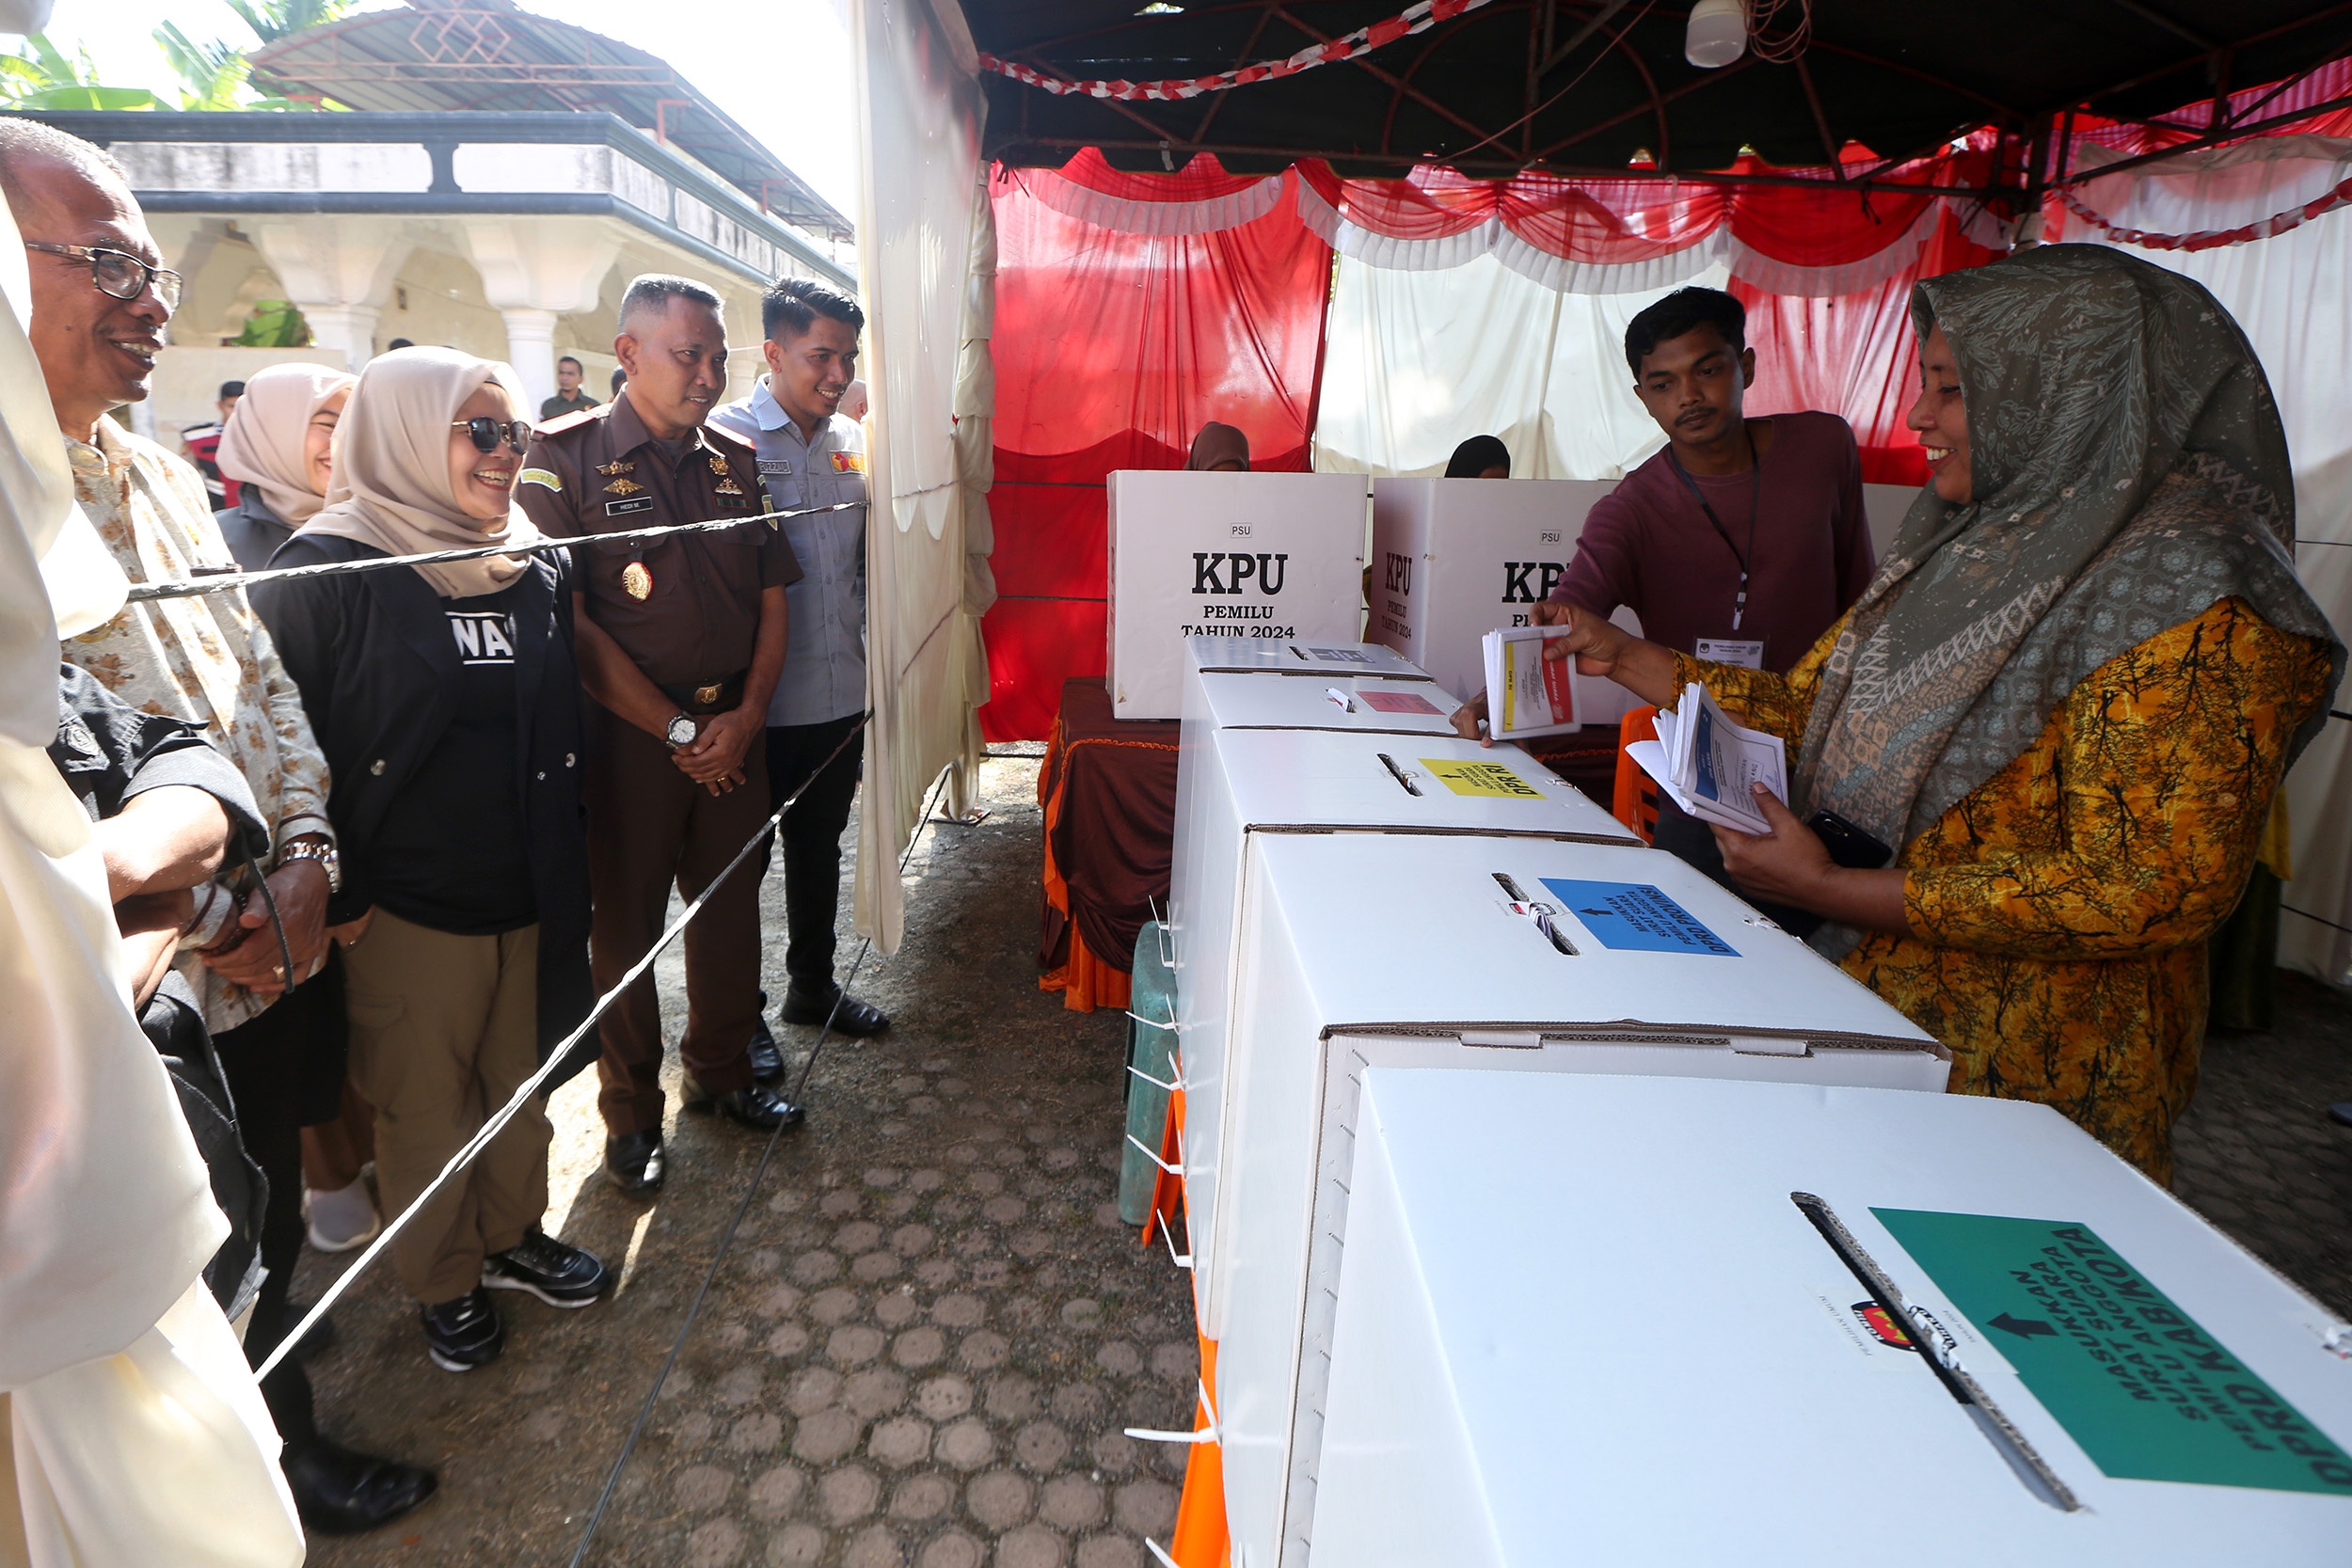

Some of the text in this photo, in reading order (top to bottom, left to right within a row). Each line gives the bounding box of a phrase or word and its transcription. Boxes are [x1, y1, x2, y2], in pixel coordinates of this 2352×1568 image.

[1232, 526, 1251, 535] PSU
[1541, 532, 1560, 542] PSU
[1191, 552, 1289, 595] KPU
[1385, 552, 1413, 596] KPU
[1502, 562, 1570, 603] KP
[1203, 605, 1275, 619] PEMILU
[1381, 615, 1412, 640] TAHUN 2024
[1387, 600, 1407, 618] PEMILU
[451, 618, 514, 657] NA
[1181, 625, 1295, 640] TAHUN 2024
[1481, 764, 1539, 796] DPR RI
[1603, 895, 1651, 933] MASUKKAN
[1615, 895, 1672, 939] SURAT SUARA
[1626, 891, 1697, 946] PEMILU ANGGOTA
[1637, 886, 1731, 953] DPRD PROVINSI
[1853, 1309, 1885, 1341] KOMISI
[2009, 1270, 2157, 1402] MASUKKAN
[2028, 1260, 2209, 1422] SURAT SUARA
[2040, 1245, 2277, 1452] PEMILU ANGGOTA
[2050, 1227, 2352, 1486] DPRD KAB/KOTA
